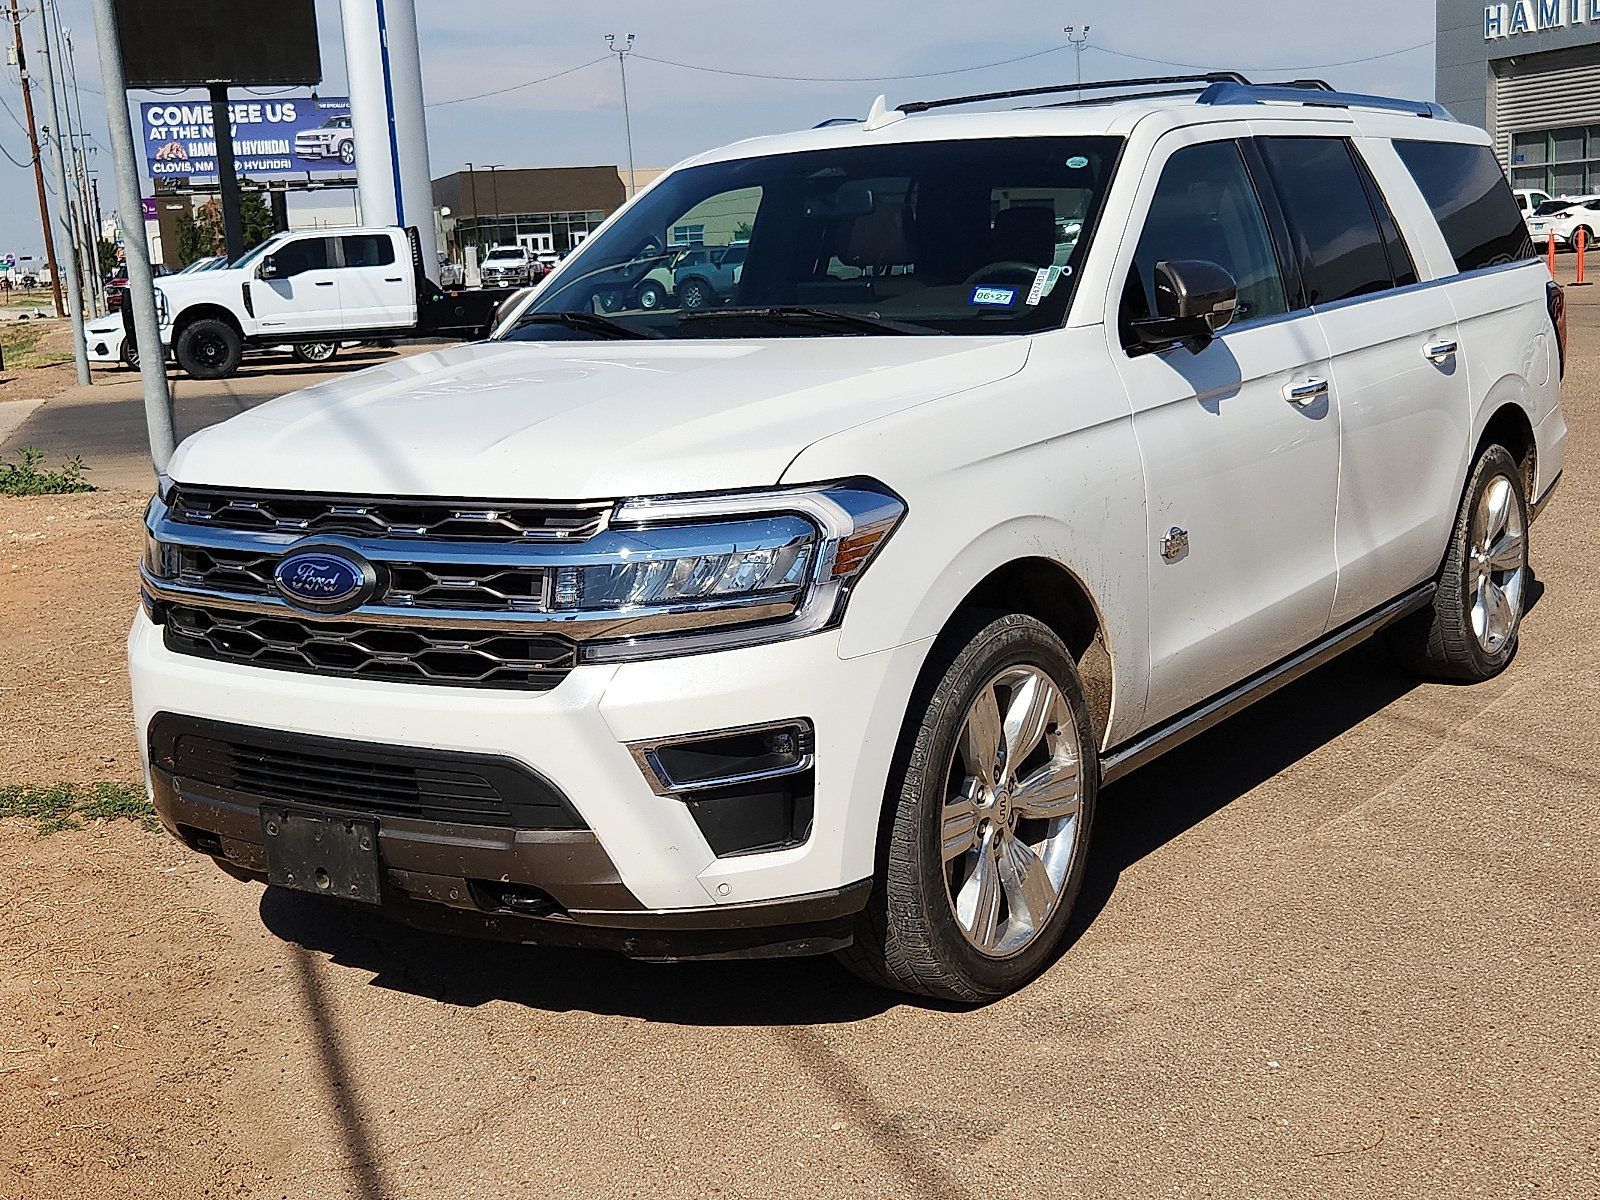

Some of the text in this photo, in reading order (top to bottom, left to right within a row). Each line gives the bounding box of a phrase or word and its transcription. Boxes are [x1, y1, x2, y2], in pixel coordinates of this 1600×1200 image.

[147, 105, 214, 126] COME
[265, 103, 297, 123] US
[149, 126, 168, 140] AT
[169, 126, 200, 139] THE
[188, 139, 290, 157] HAMIN HYUNDAI
[152, 161, 214, 174] CLOVIS, NM
[243, 159, 292, 170] HYUNDAI
[292, 562, 341, 592] Ford
